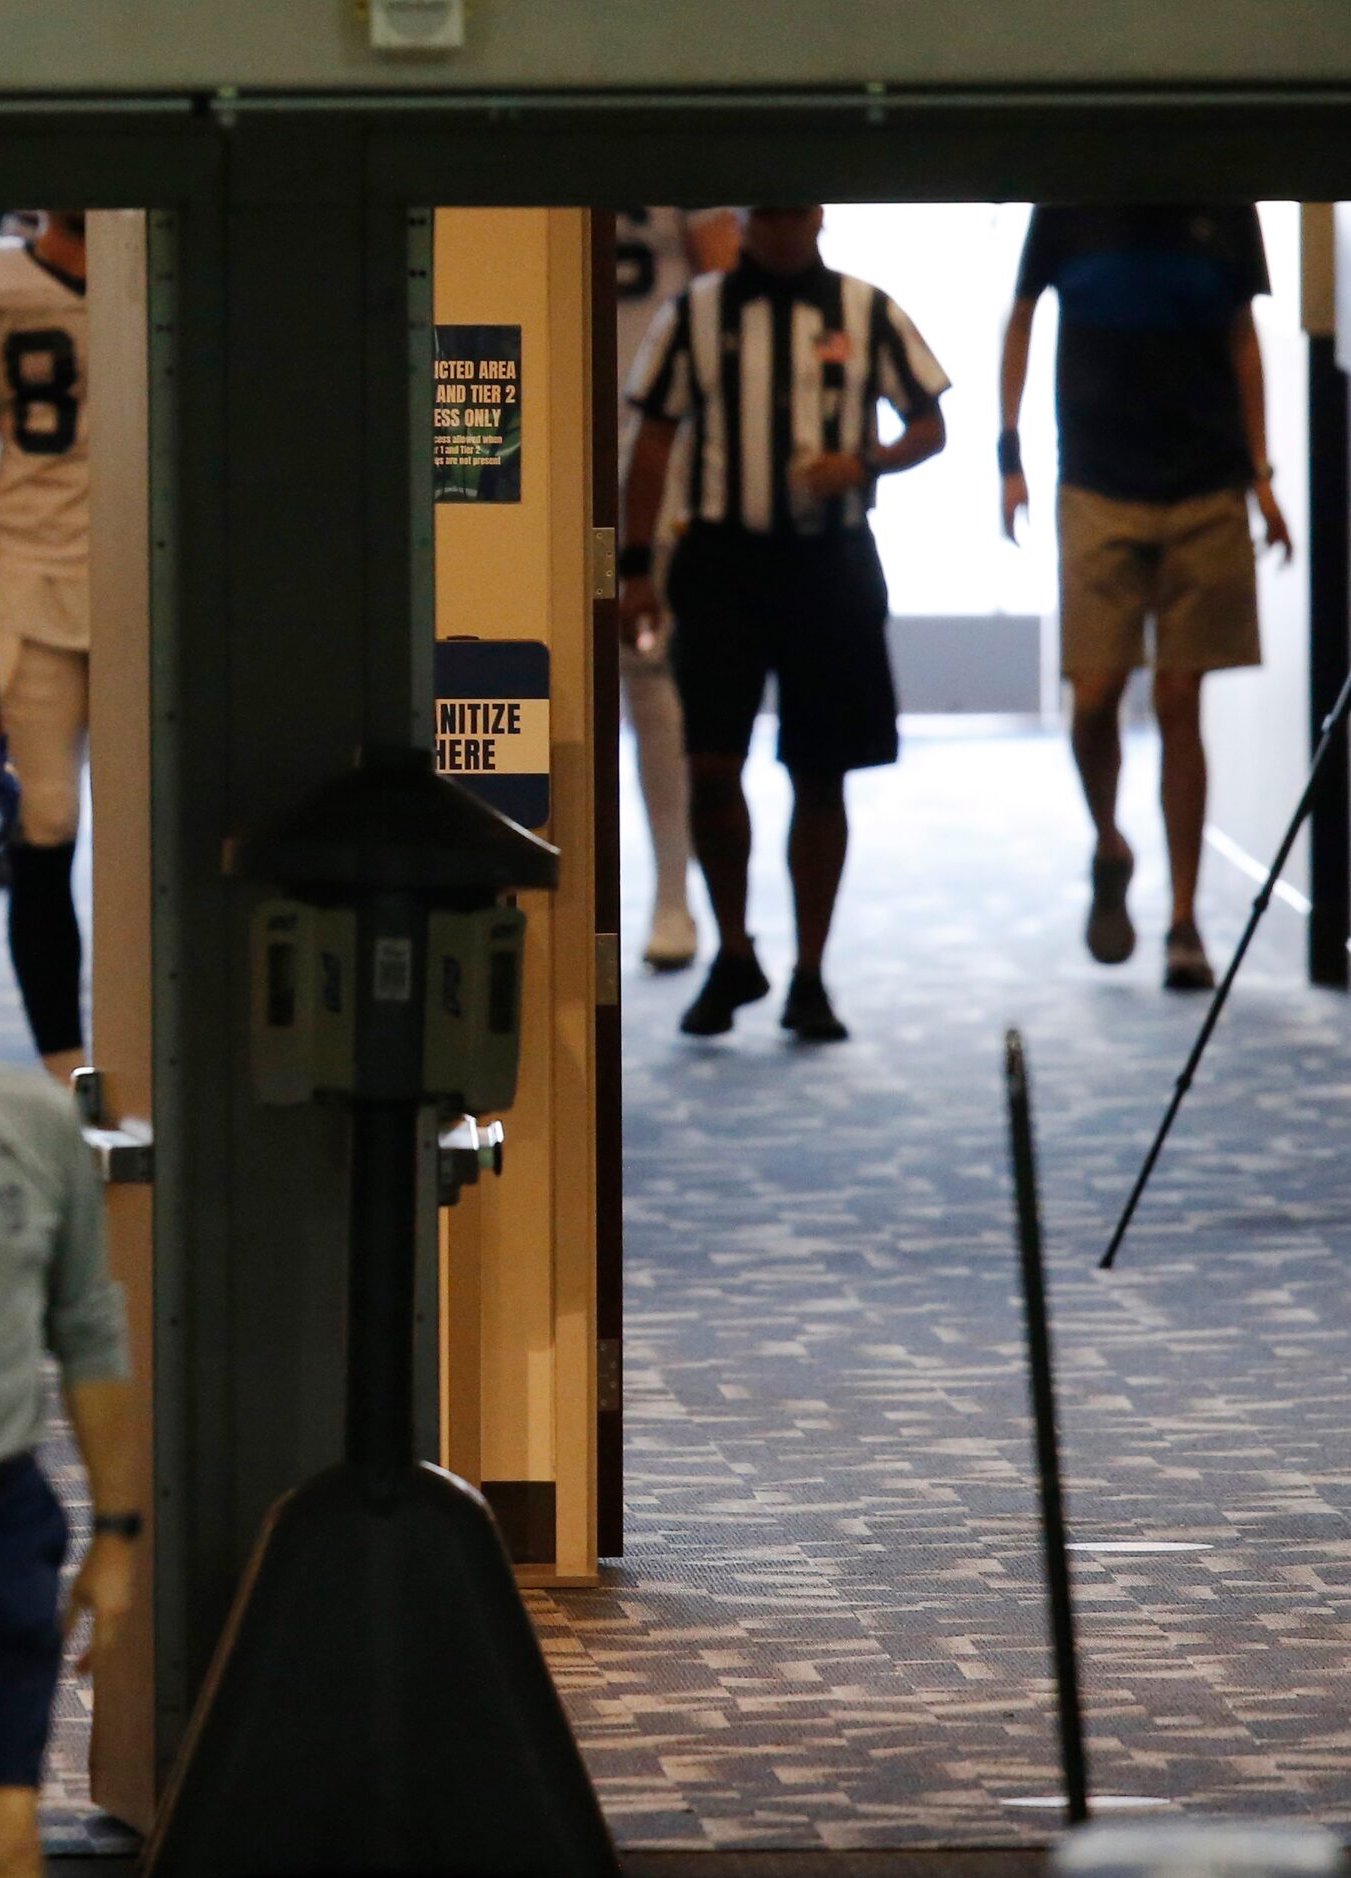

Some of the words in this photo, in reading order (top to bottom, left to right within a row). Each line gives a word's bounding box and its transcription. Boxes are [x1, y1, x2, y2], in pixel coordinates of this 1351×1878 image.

[479, 360, 517, 379] AREA
[435, 384, 467, 404] AND
[470, 384, 502, 404] TIER
[505, 384, 517, 404] 2
[464, 408, 502, 427] ONLY
[452, 434, 481, 444] allowed
[482, 434, 503, 444] when
[445, 445, 459, 454] and
[460, 445, 474, 454] Tier
[474, 445, 481, 454] 2
[445, 457, 459, 465] are
[459, 455, 471, 465] not
[472, 455, 501, 467] present
[435, 703, 521, 735] NITIZE
